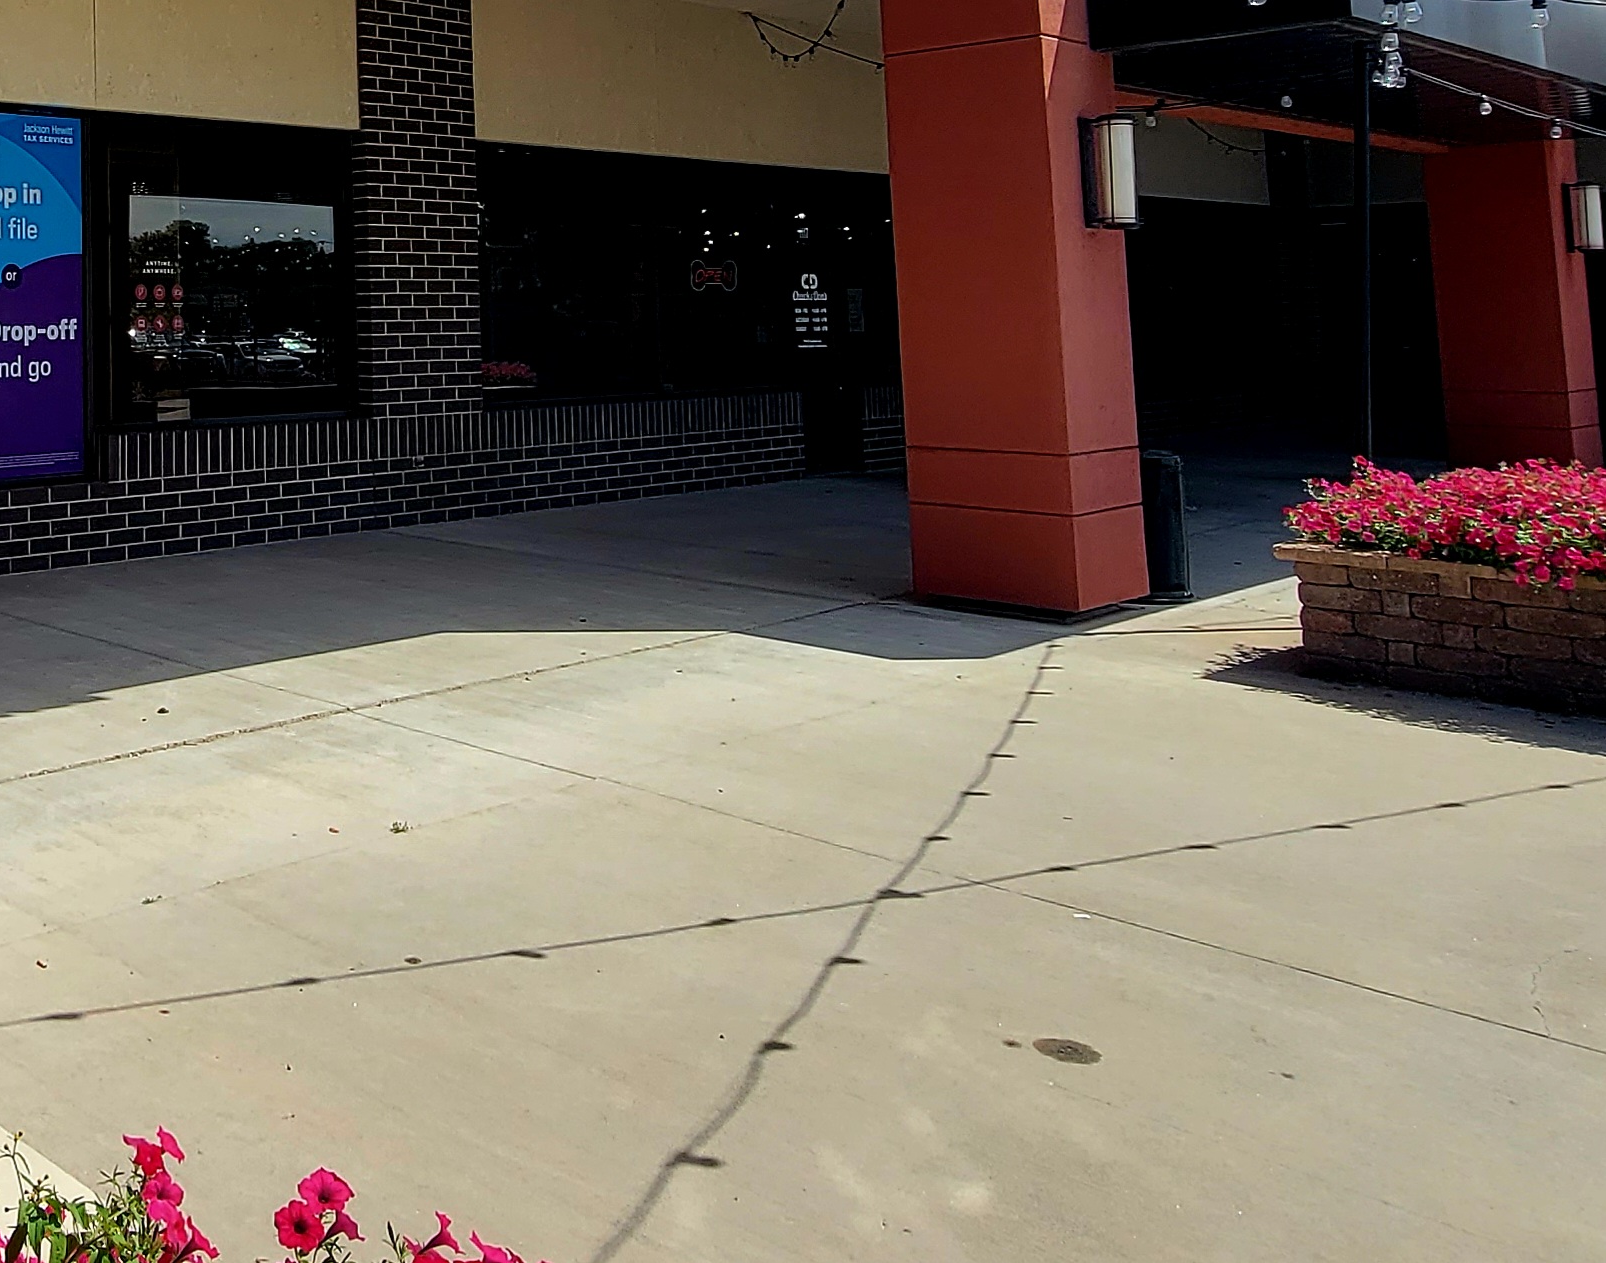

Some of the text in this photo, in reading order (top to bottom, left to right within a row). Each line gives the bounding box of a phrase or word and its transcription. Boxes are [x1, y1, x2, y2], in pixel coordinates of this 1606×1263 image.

[23, 134, 38, 143] TAX
[22, 182, 42, 205] in
[7, 217, 38, 240] file
[5, 270, 18, 282] or
[695, 269, 733, 283] OPEN
[27, 360, 52, 383] go
